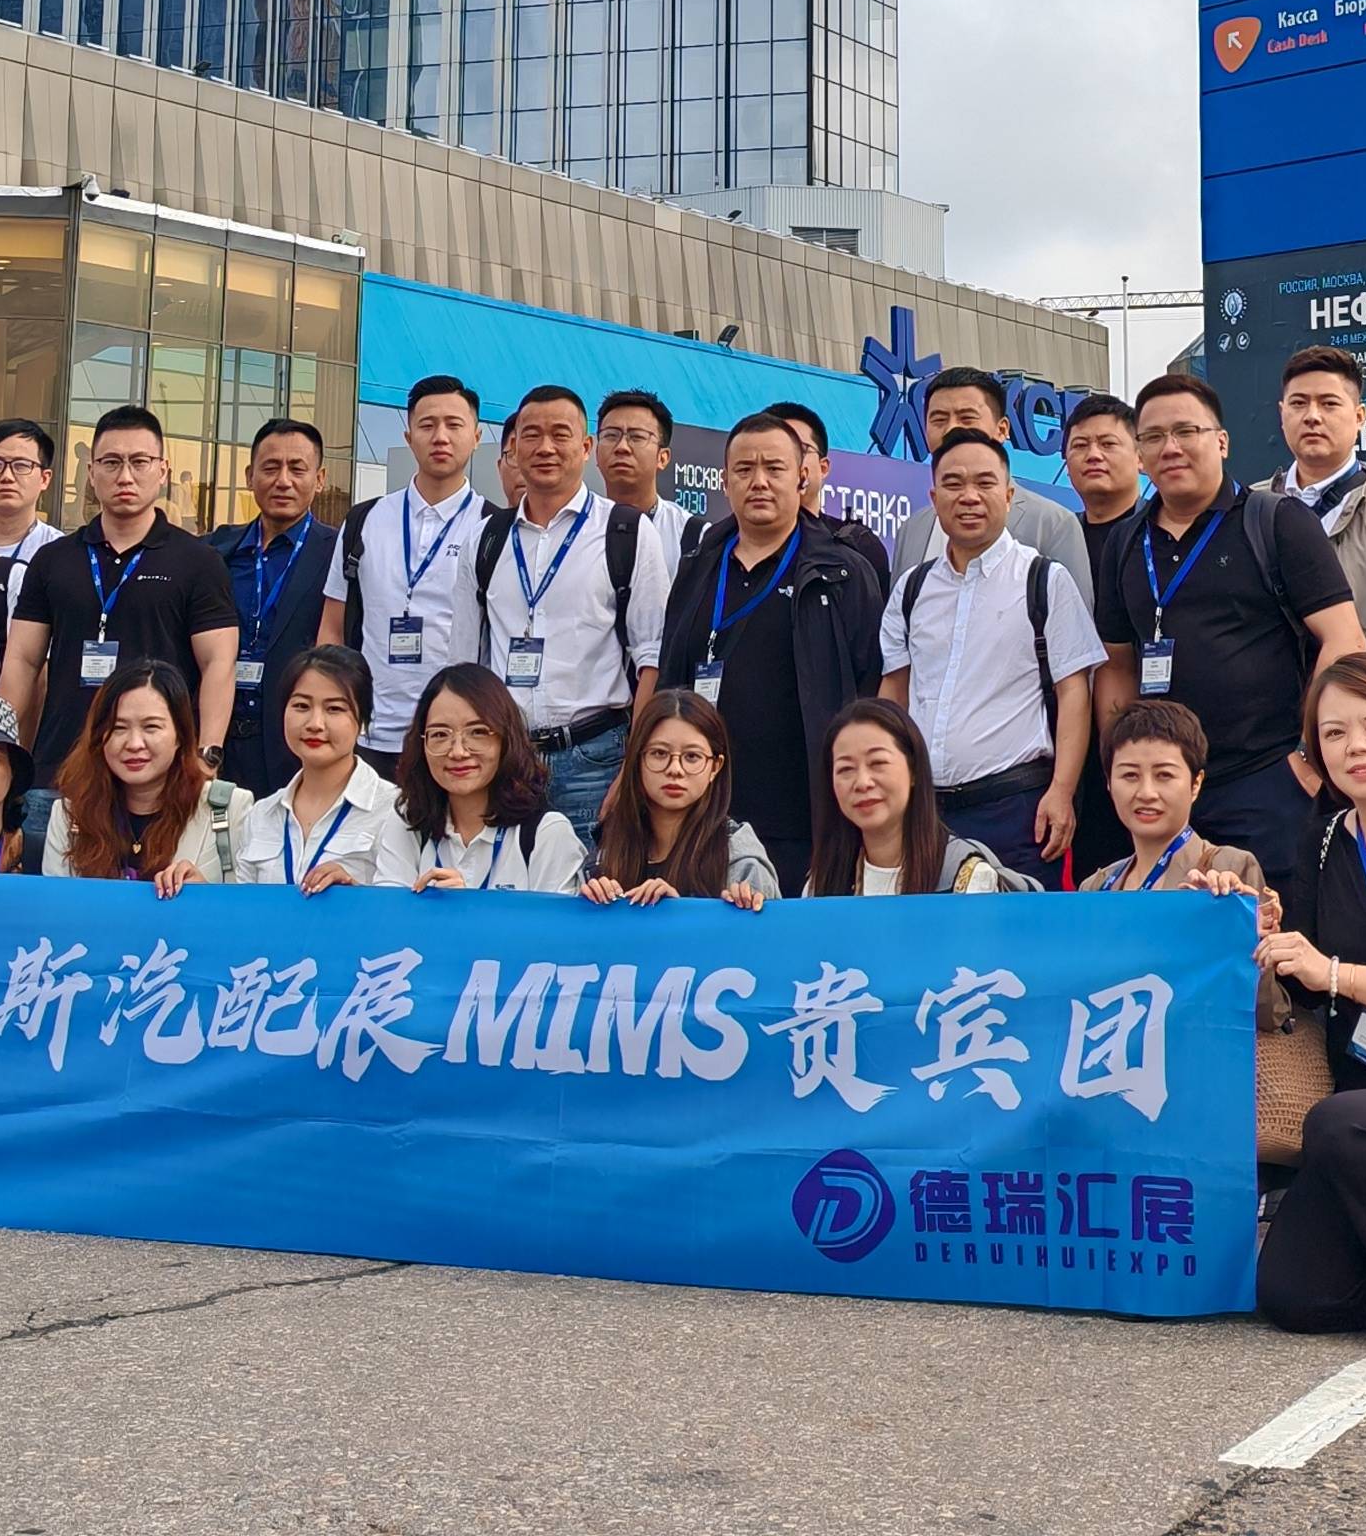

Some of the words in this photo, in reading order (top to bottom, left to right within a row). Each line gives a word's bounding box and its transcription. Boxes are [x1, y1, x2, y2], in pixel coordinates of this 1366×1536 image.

[1278, 9, 1317, 28] Касса
[1267, 36, 1296, 53] Cash
[1299, 30, 1327, 47] Desk
[675, 488, 707, 515] 2030
[910, 1169, 1196, 1245] 德瑞汇展
[914, 1242, 1197, 1277] DERUIHUIEXPO
